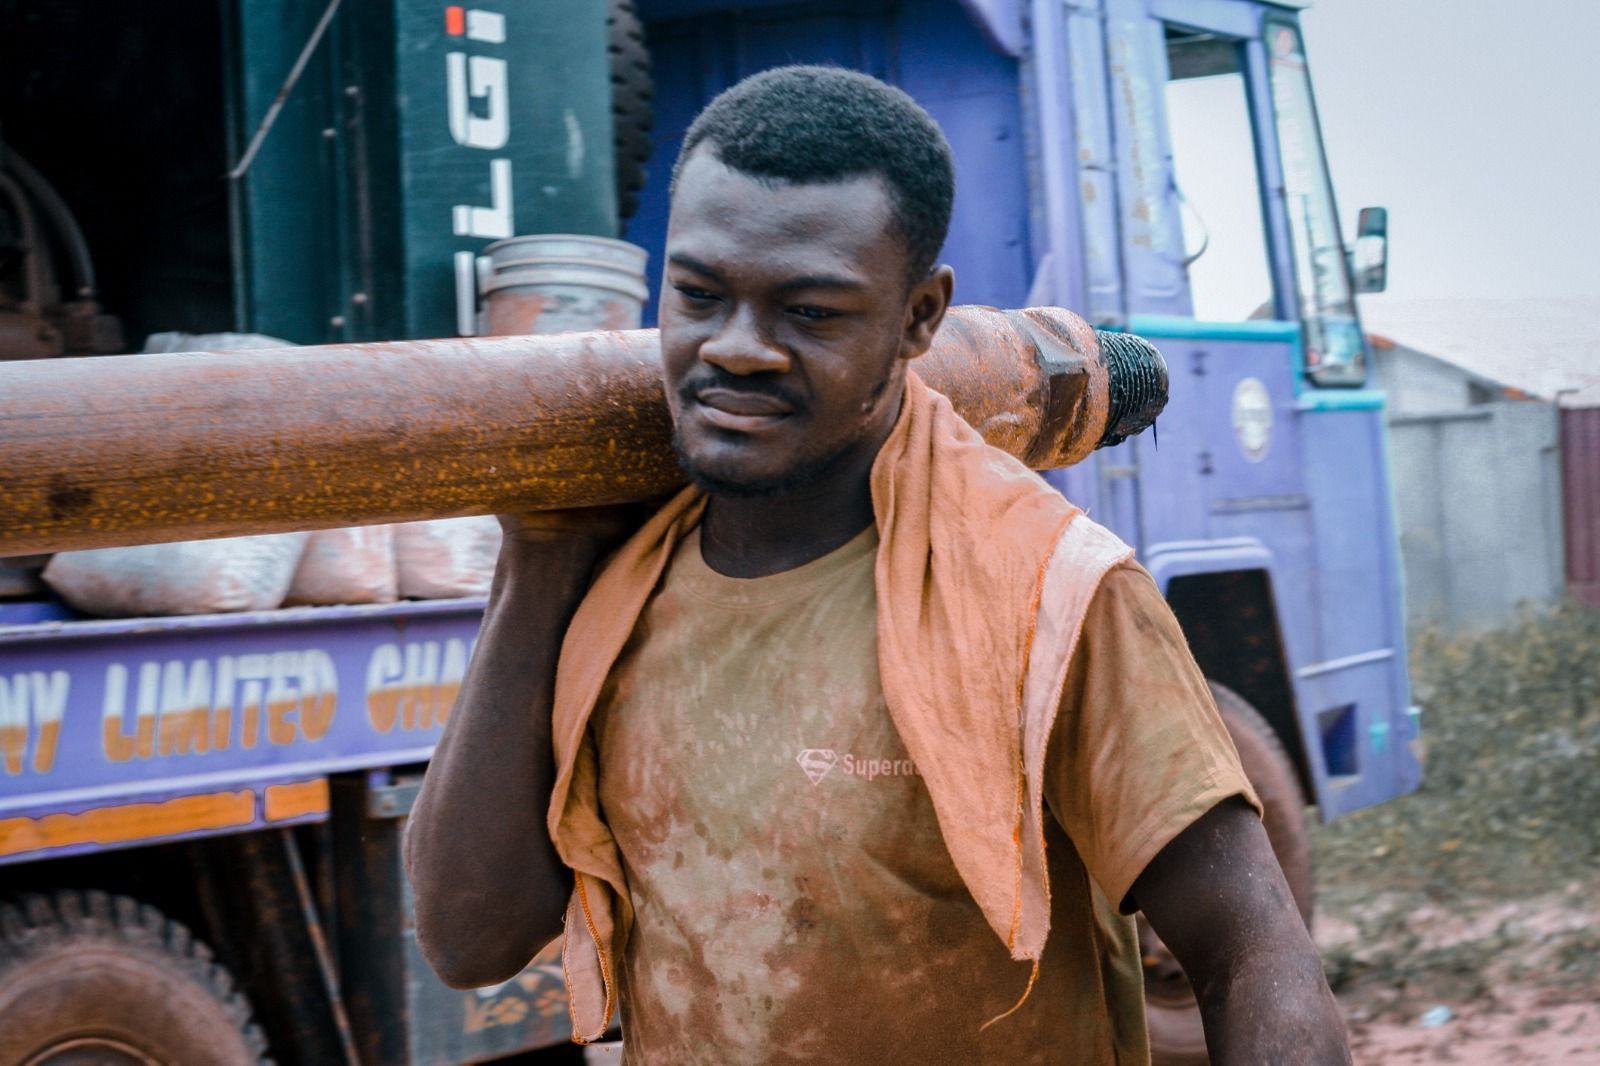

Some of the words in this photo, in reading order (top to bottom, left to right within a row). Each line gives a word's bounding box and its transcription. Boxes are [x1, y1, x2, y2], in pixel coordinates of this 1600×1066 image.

[103, 649, 338, 762] LIMITED
[366, 639, 478, 734] GHA
[843, 753, 922, 781] Superd
